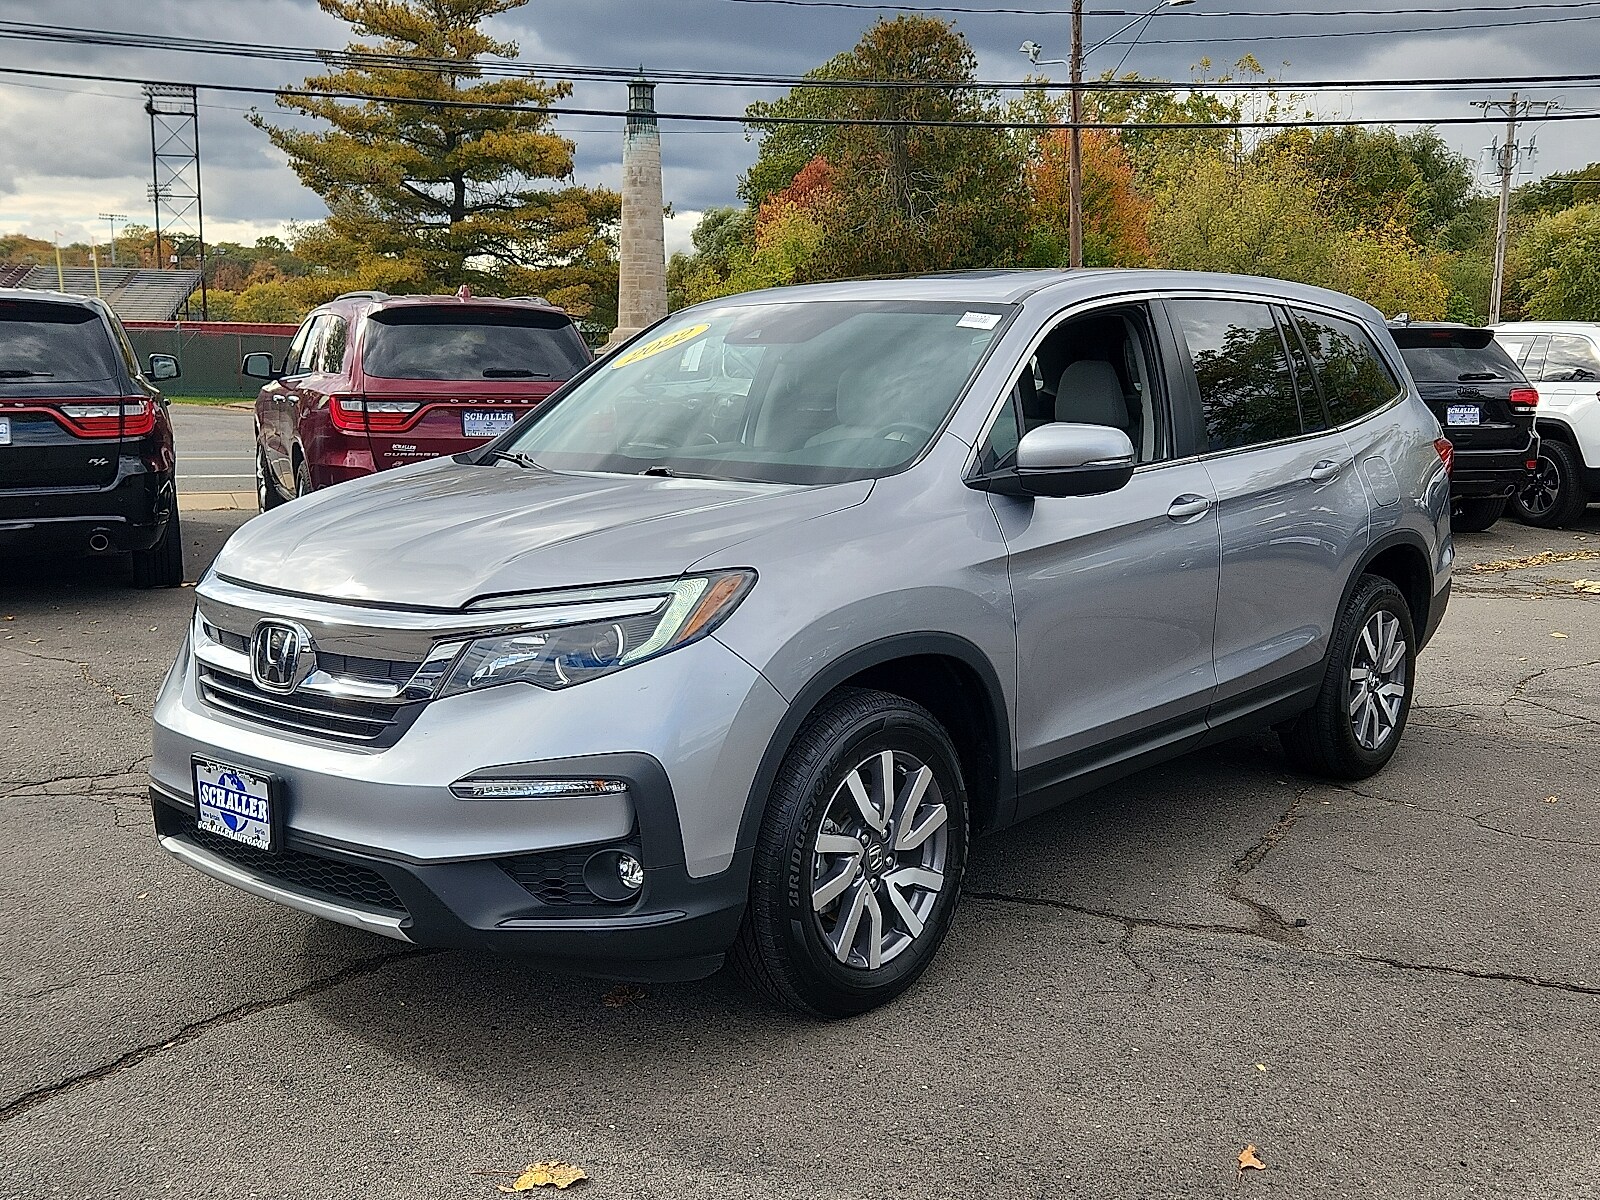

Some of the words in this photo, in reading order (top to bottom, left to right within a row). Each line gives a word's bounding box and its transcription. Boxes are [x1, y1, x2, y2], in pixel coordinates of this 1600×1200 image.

[623, 328, 696, 364] 2022
[465, 412, 513, 422] SCHALLER
[201, 784, 268, 823] SCHALLER
[788, 756, 839, 908] BRIDGESTONE
